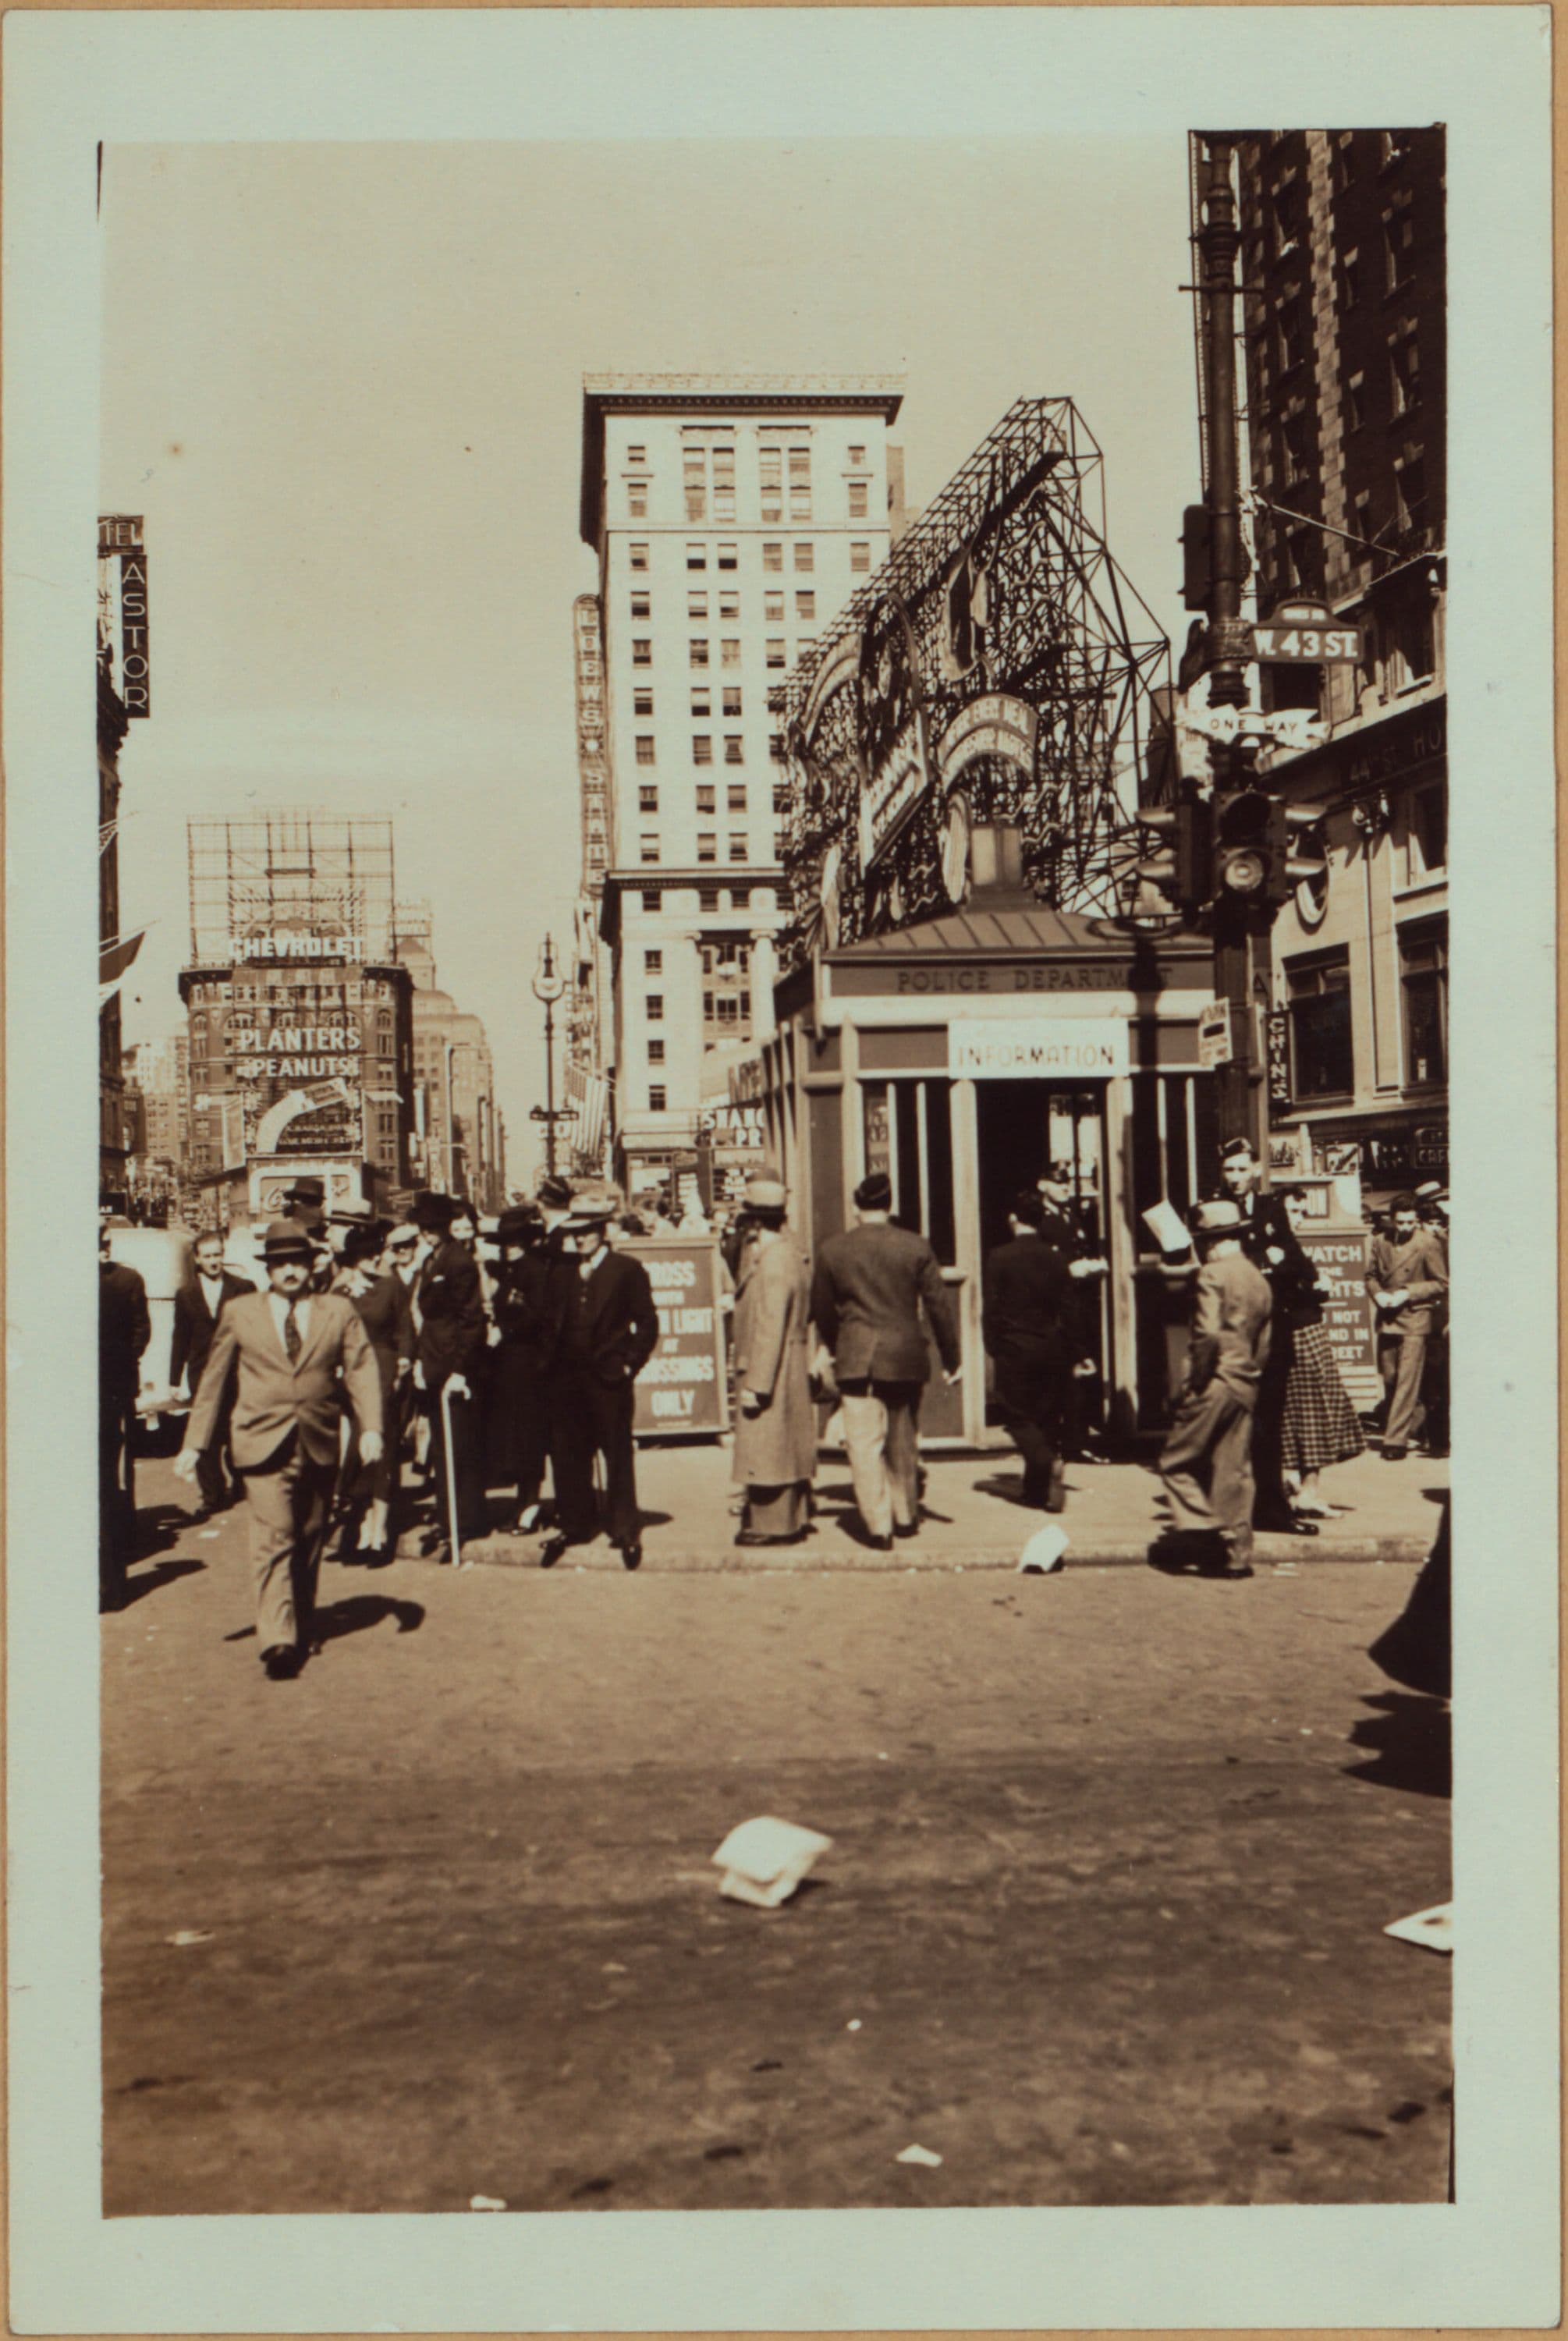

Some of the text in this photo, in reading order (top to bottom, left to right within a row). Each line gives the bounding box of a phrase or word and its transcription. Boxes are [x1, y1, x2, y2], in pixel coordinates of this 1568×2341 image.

[122, 561, 148, 710] ASTOR
[1279, 629, 1320, 658] 43
[1210, 718, 1298, 734] ONE WAY
[229, 935, 362, 965] CHEVROLET
[897, 967, 1172, 991] POLICE DEPARTMT
[240, 1027, 361, 1052] PLANTERS
[254, 1055, 349, 1078] PEANUTS
[958, 1045, 1114, 1066] INFORMATION
[642, 1261, 696, 1287] ROSS
[1329, 1279, 1365, 1298] HTS
[1332, 1310, 1361, 1324] NOT
[1353, 1328, 1369, 1341] IN
[651, 1389, 694, 1417] ONLY
